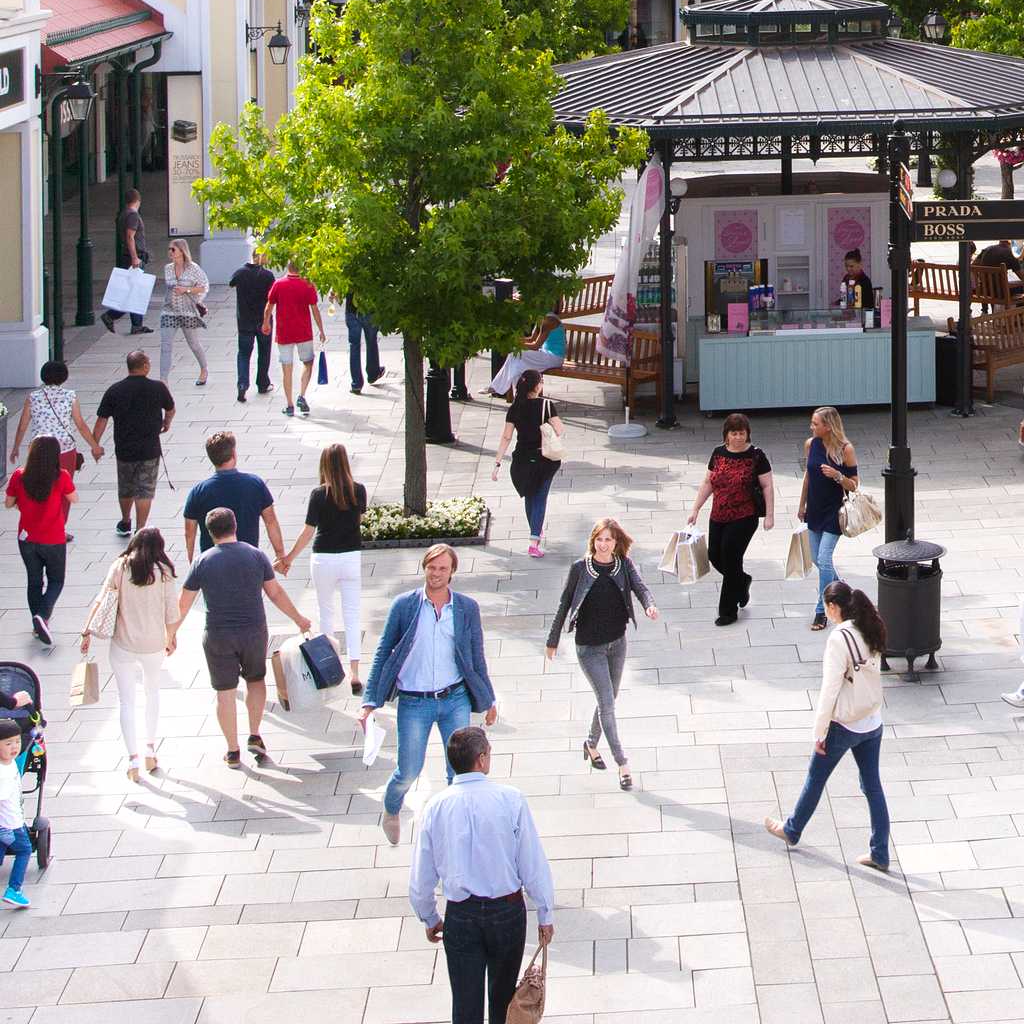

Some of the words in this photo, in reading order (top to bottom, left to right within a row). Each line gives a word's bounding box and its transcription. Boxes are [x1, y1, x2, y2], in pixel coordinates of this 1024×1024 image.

[173, 160, 200, 169] JEANS
[924, 205, 983, 217] PRADA
[924, 223, 966, 237] BOSS
